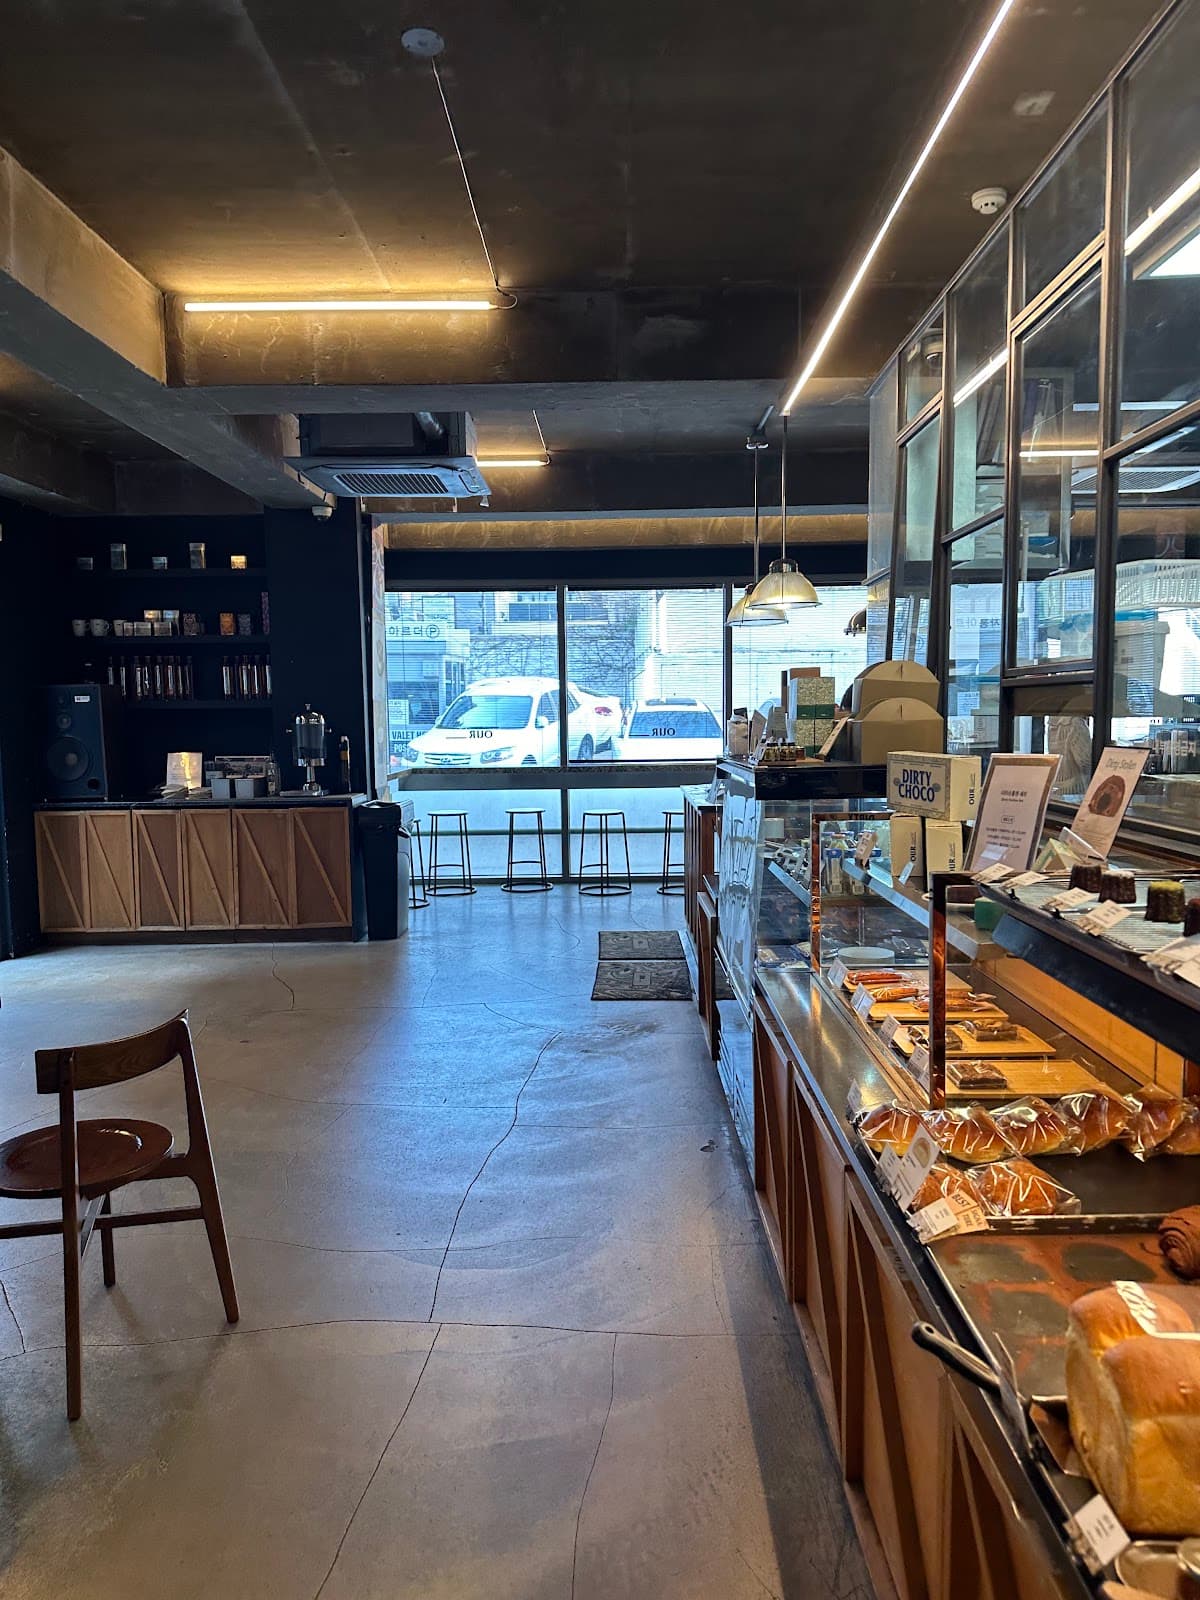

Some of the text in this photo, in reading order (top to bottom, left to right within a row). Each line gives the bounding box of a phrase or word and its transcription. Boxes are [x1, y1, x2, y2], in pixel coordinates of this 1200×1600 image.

[392, 731, 415, 740] VALET
[394, 743, 407, 753] POS
[902, 768, 932, 787] DIRTY
[898, 783, 935, 803] CHOCO
[952, 1193, 971, 1207] BEST
